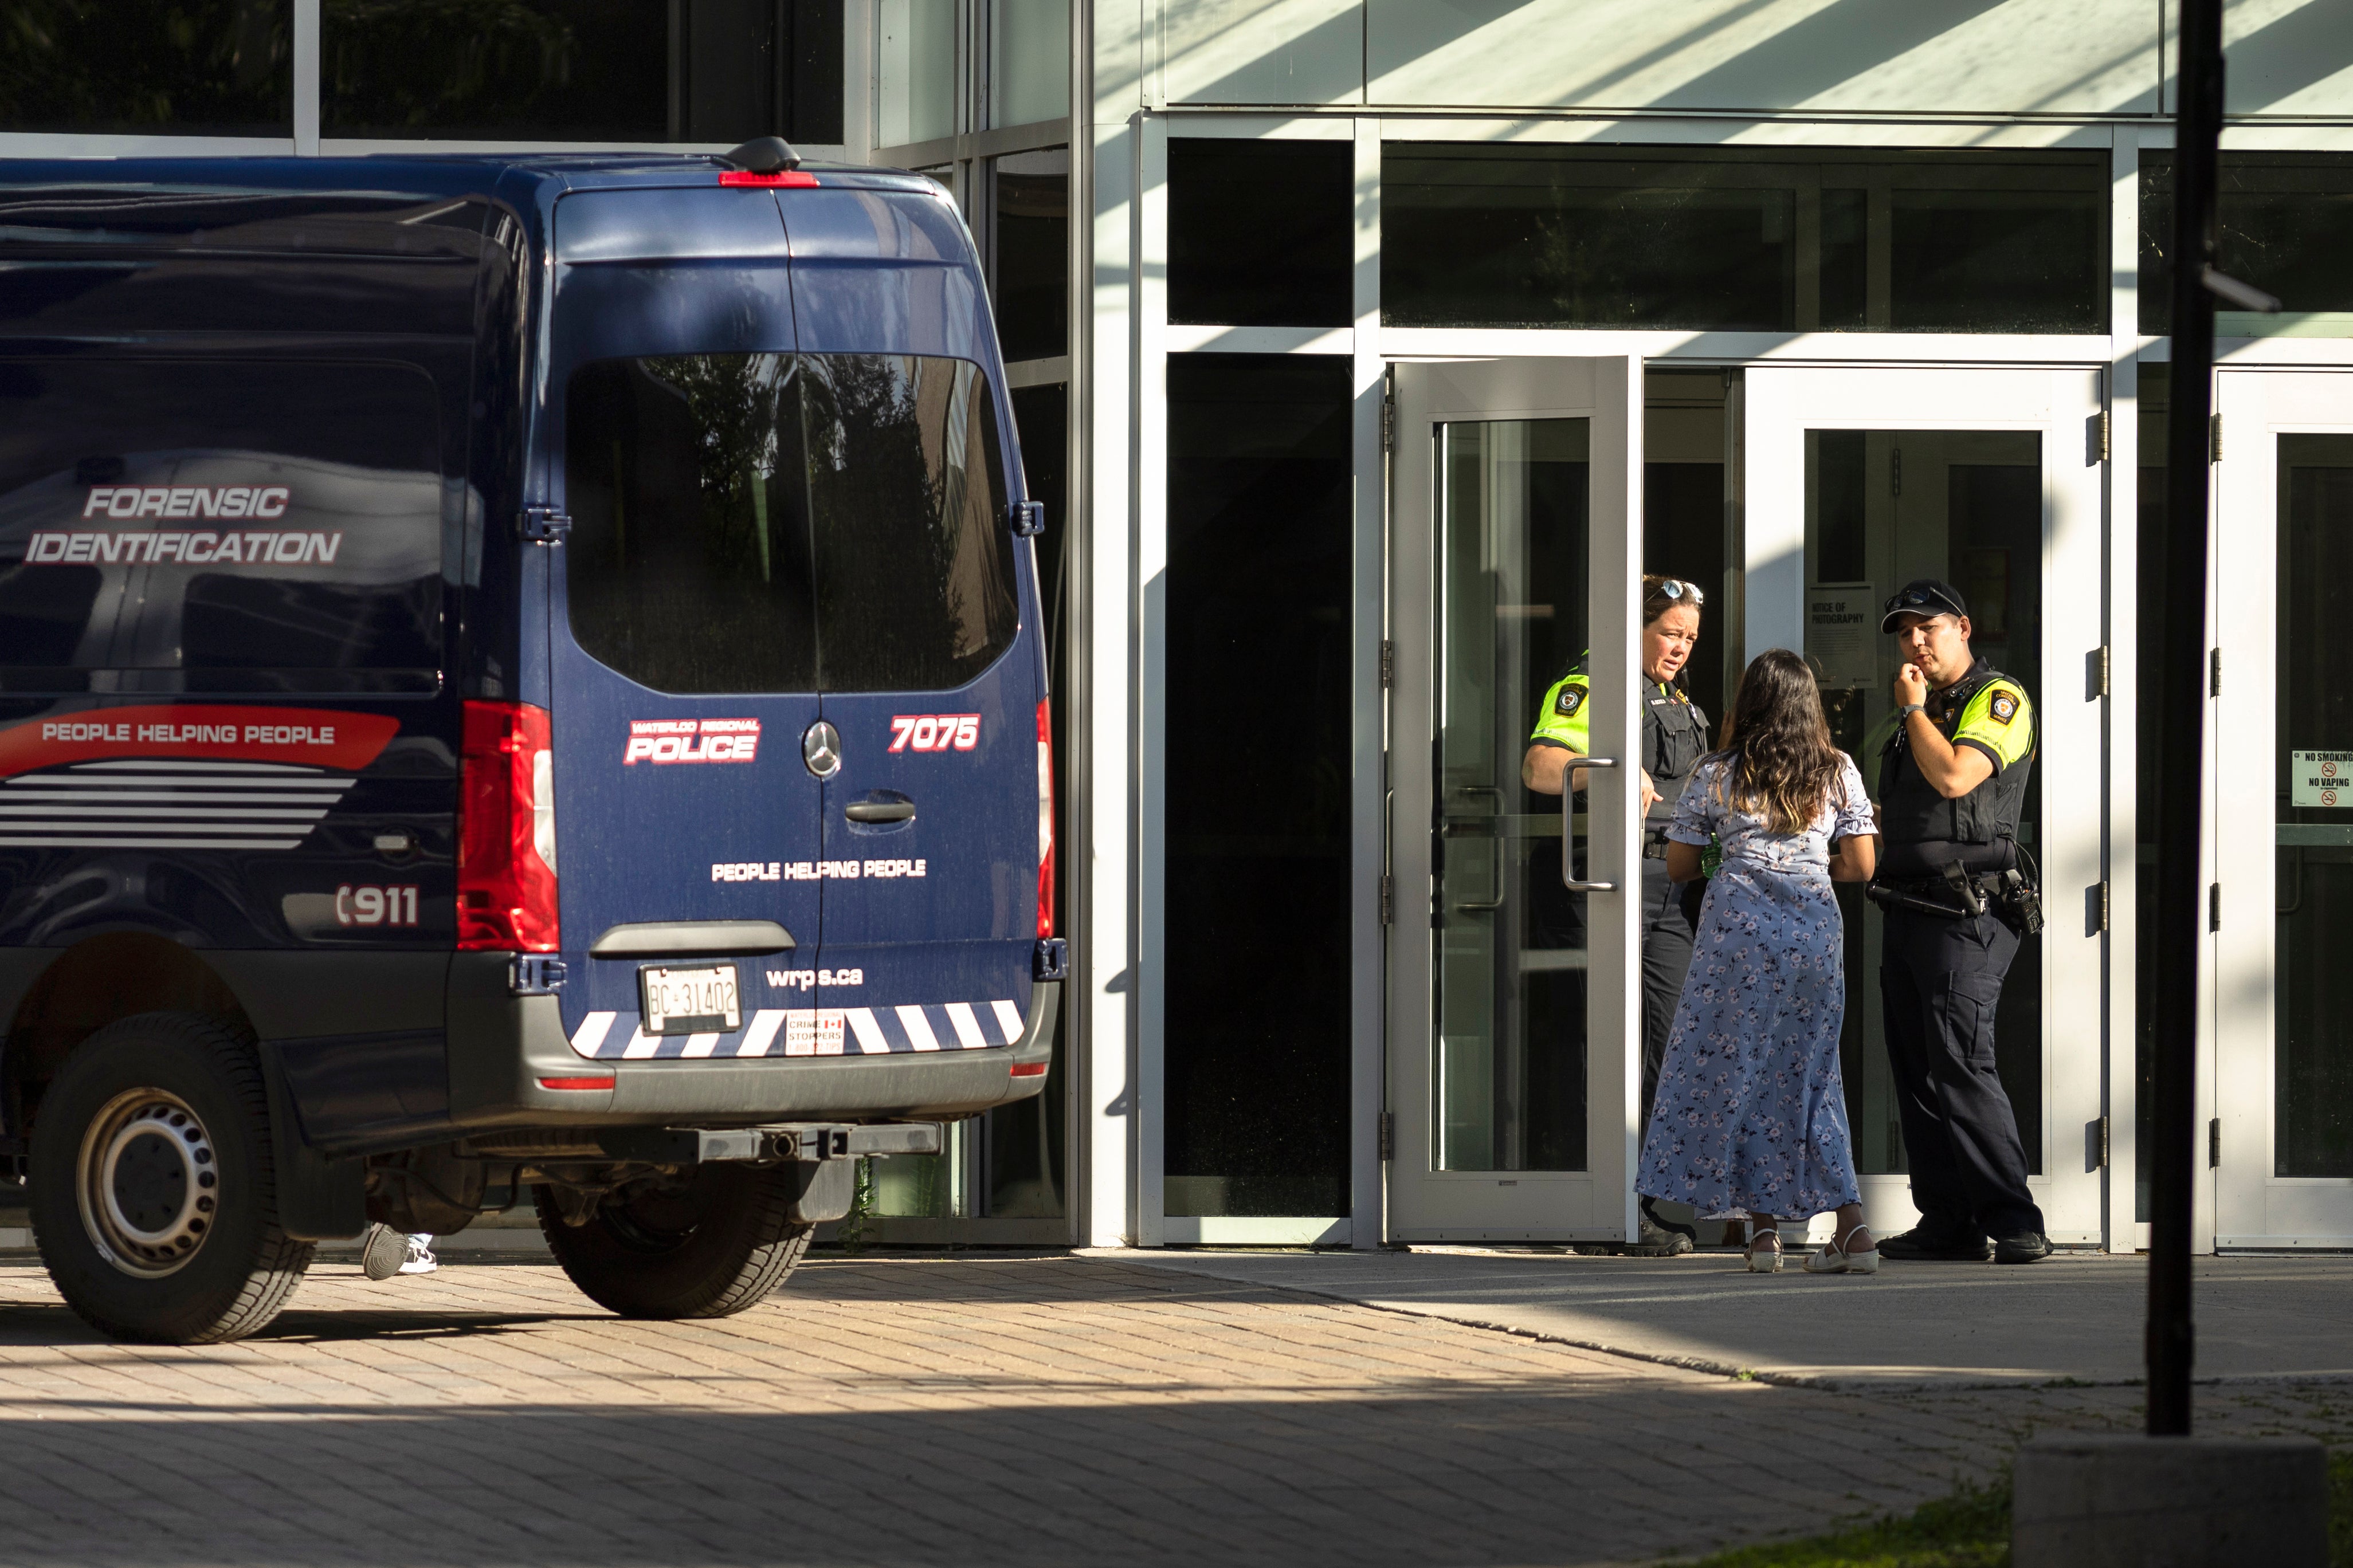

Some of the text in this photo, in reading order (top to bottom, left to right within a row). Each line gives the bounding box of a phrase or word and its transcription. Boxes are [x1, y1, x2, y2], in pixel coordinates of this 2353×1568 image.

[83, 488, 289, 517] FORENSIC
[25, 533, 340, 561] IDENTIFICATION
[1812, 603, 1846, 612] NOTICE OF
[1812, 613, 1864, 624] PHOTOGRAPHY
[42, 724, 335, 744] PEOPLE HELPING PEOPLE
[632, 721, 759, 733] WATERLOO REGIONAL
[892, 717, 979, 749] 7075
[626, 736, 758, 762] POLICE
[2305, 753, 2316, 761] NO
[2309, 778, 2350, 787] NO VAPING
[712, 859, 926, 882] PEOPLE HELPING PEOPLE
[355, 887, 416, 923] 911
[766, 969, 863, 991] wrps.ca
[683, 981, 735, 1013] 31402
[789, 1020, 821, 1028] CRIME
[789, 1032, 841, 1040] STOPPERS
